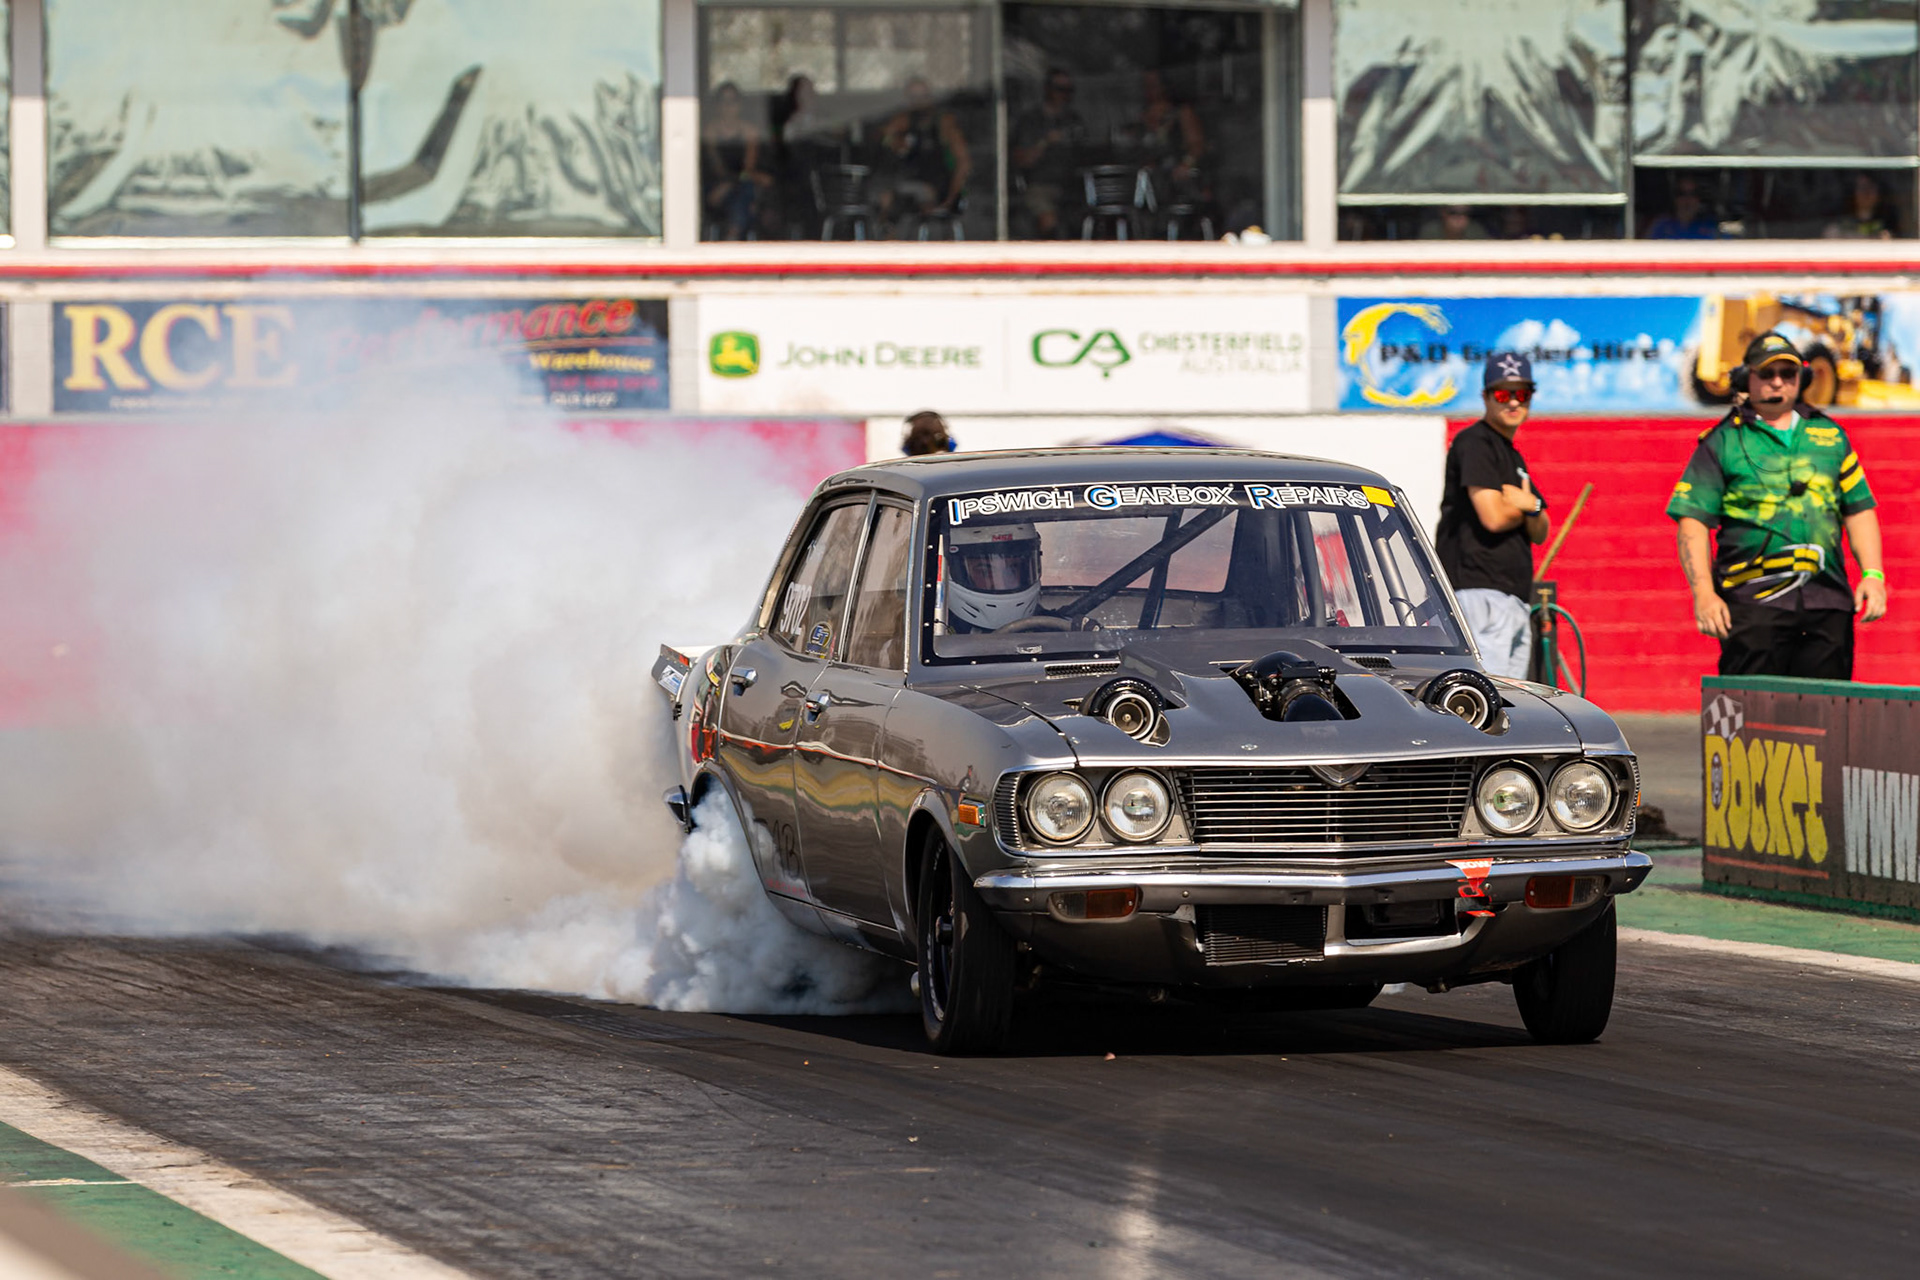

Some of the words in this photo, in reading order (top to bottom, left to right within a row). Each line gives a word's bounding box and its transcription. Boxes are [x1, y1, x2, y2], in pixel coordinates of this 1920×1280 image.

[63, 303, 301, 392] RCE
[778, 342, 866, 369] JOHN
[876, 342, 982, 368] DEERE
[1138, 332, 1305, 355] CHESTERFIELD
[1380, 343, 1448, 362] P&D
[1462, 342, 1574, 361] Grder
[1591, 343, 1660, 361] Hire
[949, 490, 1073, 525] IPSWICH
[1084, 484, 1237, 510] GEARBOX
[1247, 483, 1371, 510] REPAIRS
[1705, 735, 1828, 864] ROCKET
